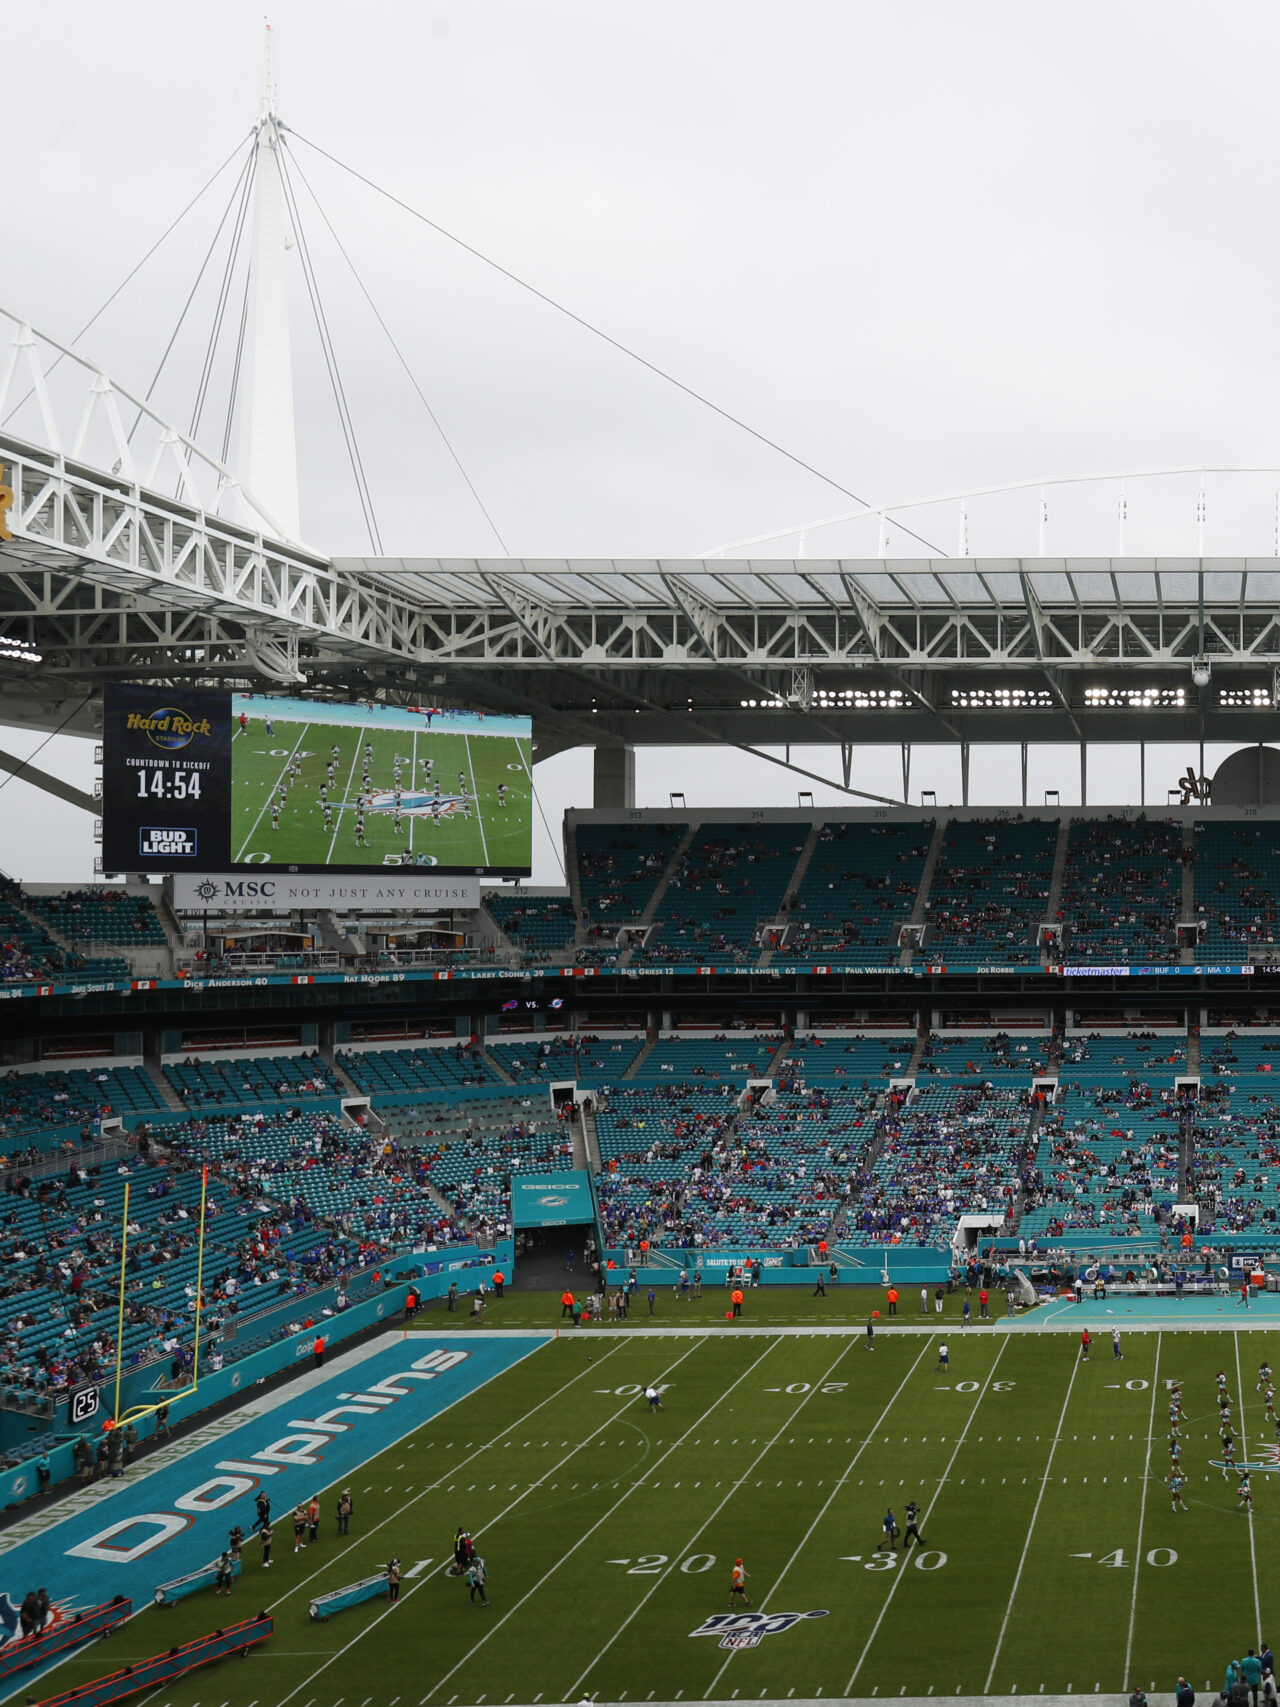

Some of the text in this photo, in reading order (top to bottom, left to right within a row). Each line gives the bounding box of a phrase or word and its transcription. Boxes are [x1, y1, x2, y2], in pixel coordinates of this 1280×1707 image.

[126, 713, 212, 736] Hard Rock
[126, 758, 211, 770] COUNTDOWN TO KICKOFF
[137, 769, 201, 799] 14:54
[873, 810, 887, 818] 315
[1243, 808, 1257, 816] 318
[149, 830, 187, 842] BUD
[142, 841, 194, 853] LIGHT
[224, 882, 276, 897] MSC
[289, 888, 469, 898] NOT JUST ANY CRUISE
[514, 887, 529, 895] 312
[471, 971, 496, 979] LARRY
[498, 970, 531, 978] CSONKA
[734, 967, 749, 975] JIM
[750, 967, 779, 975] LANGER
[1066, 967, 1123, 976] ticketmaster
[184, 978, 268, 988] DICK ANDERSON 40
[361, 974, 390, 982] MOORE
[392, 974, 405, 982] 89
[86, 984, 106, 993] SCOTT
[784, 1382, 849, 1394] 20
[954, 1380, 1017, 1393] 30
[76, 1391, 95, 1416] 25
[145, 1410, 260, 1462] SERVICE
[62, 1347, 470, 1562] Dolphins
[626, 1553, 717, 1574] 20
[864, 1550, 948, 1571] 30
[1097, 1547, 1179, 1568] 40
[687, 1612, 802, 1637] 100
[724, 1637, 757, 1647] NFL
